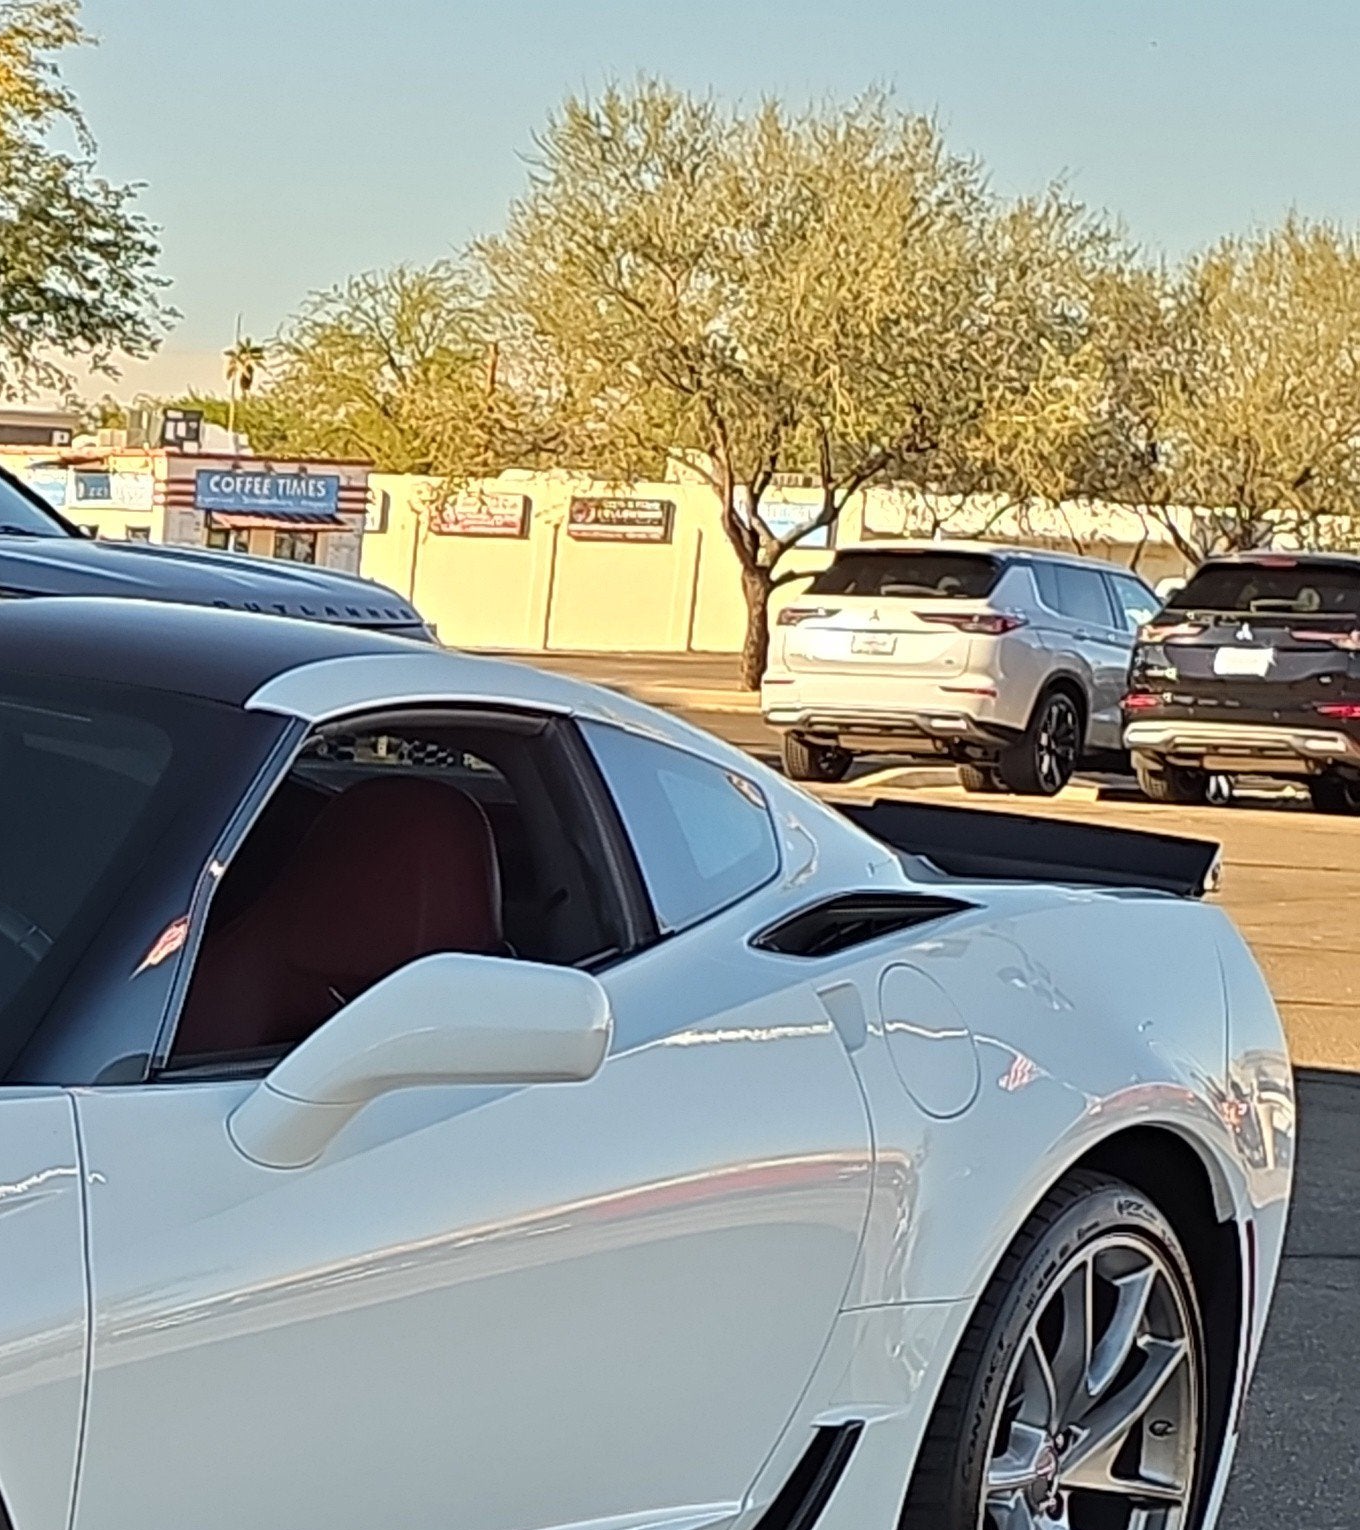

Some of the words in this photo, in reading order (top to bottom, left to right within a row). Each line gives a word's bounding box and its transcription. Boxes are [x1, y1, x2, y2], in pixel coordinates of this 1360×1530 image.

[209, 475, 271, 495] COFFEE
[277, 478, 327, 498] TIMES
[213, 599, 414, 621] OUTLANDER
